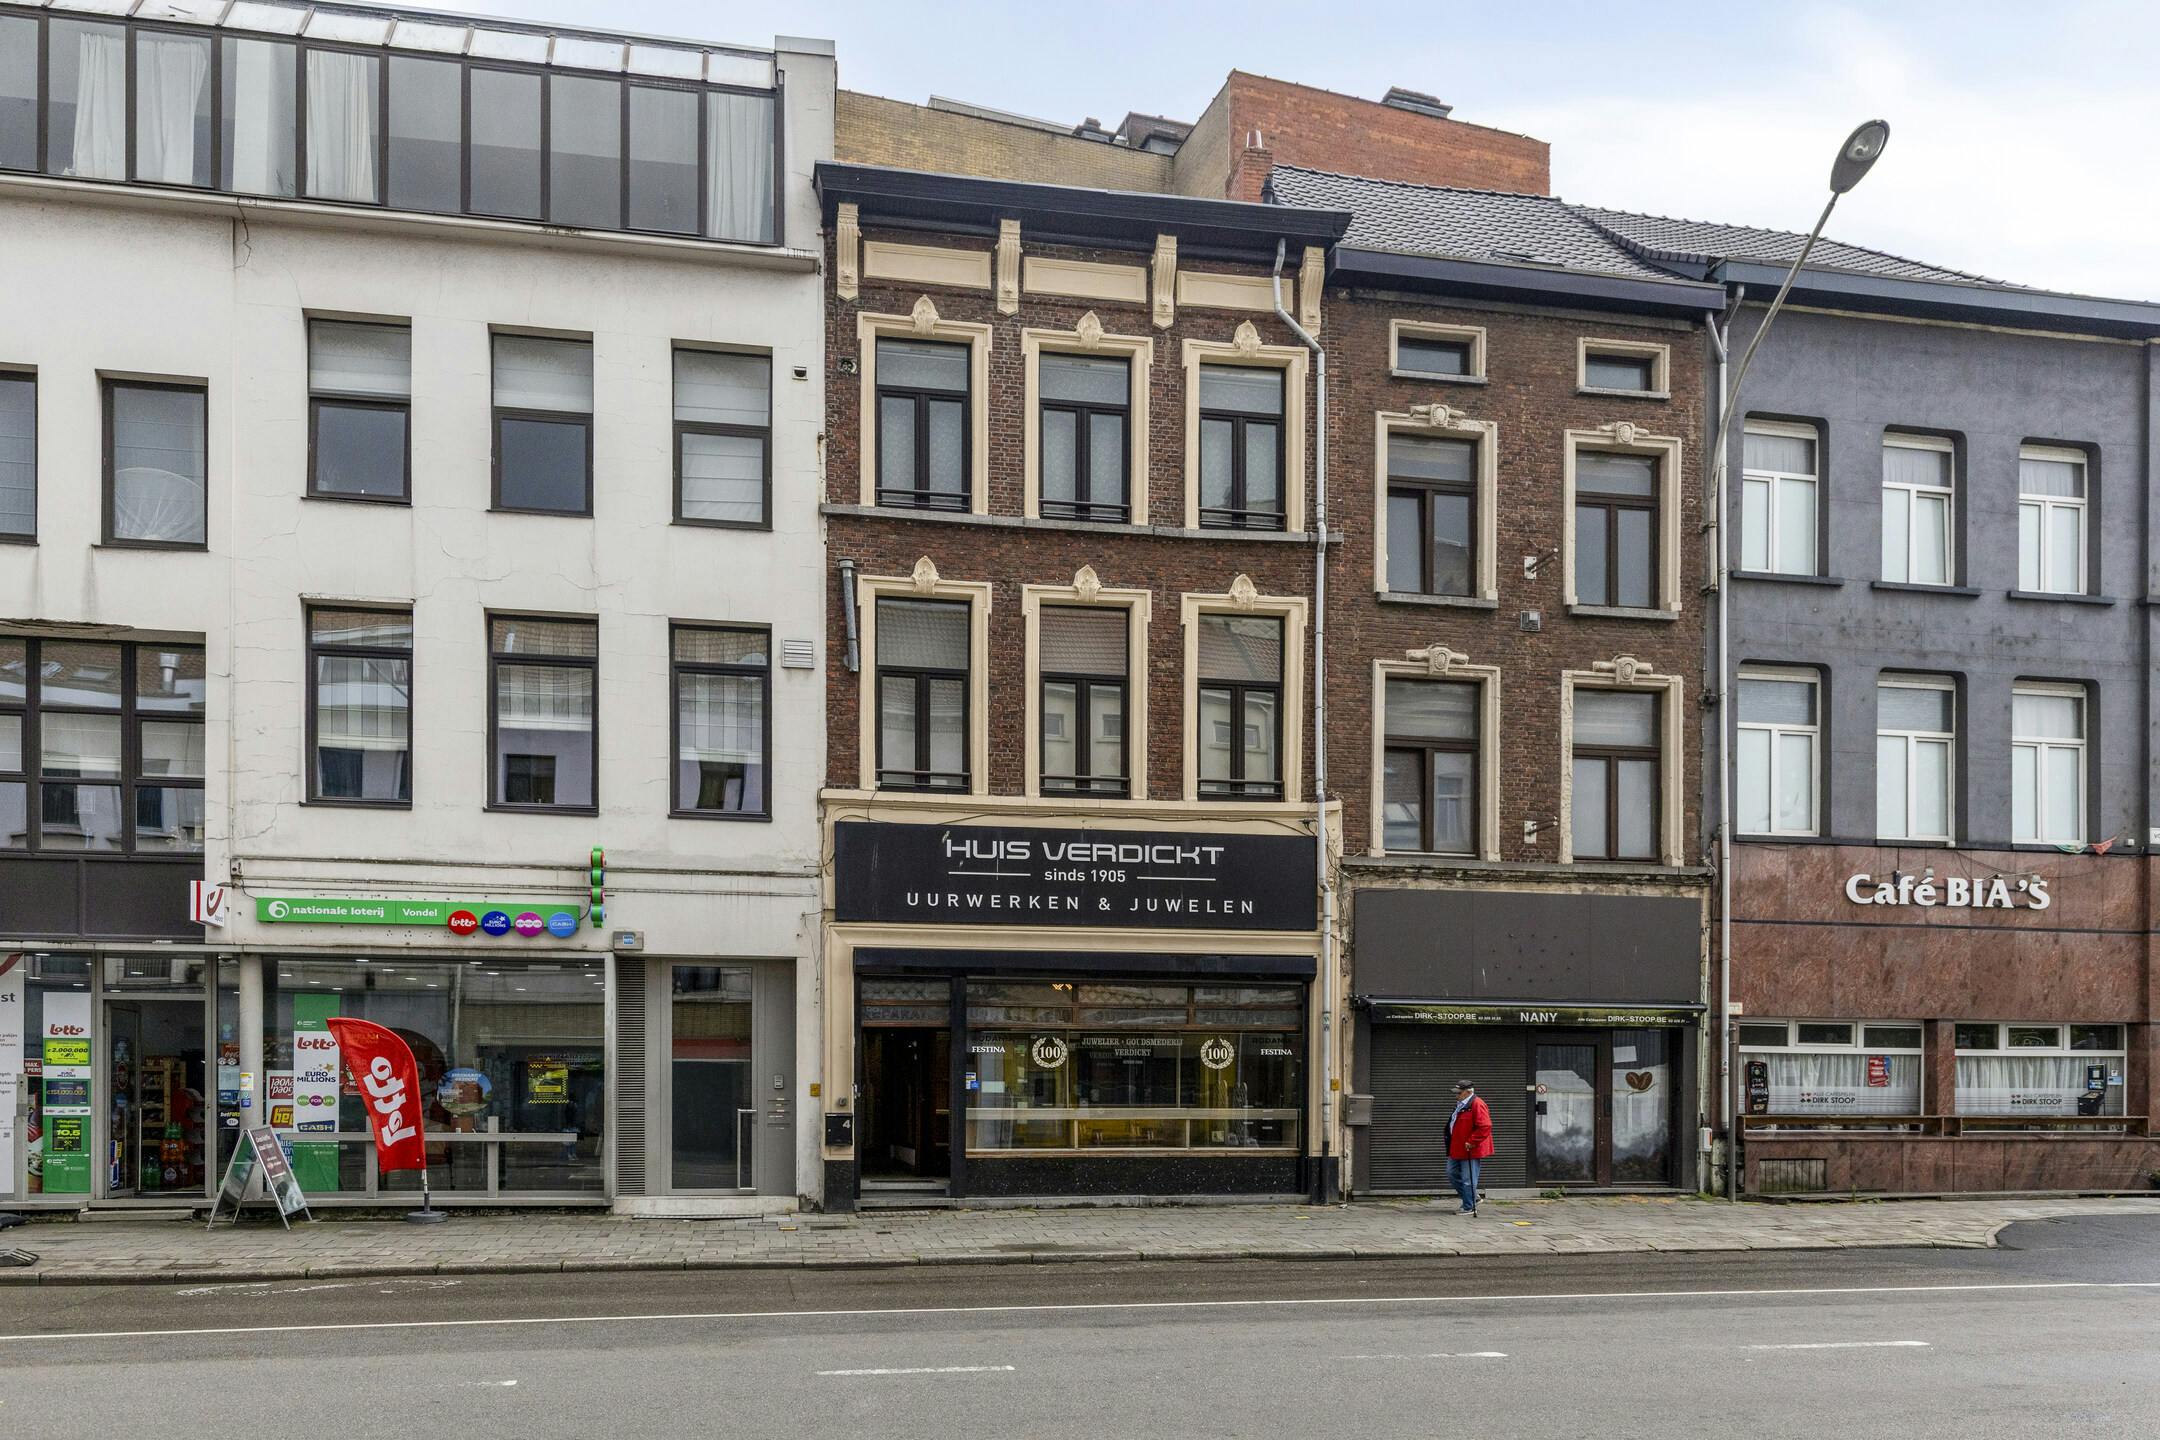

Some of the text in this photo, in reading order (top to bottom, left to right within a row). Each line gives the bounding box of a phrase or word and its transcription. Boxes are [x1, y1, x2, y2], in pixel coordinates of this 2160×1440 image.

[946, 839, 1225, 865] HUIS VERDICKT
[1044, 868, 1126, 883] sinds 1905
[1845, 874, 1937, 906] Café
[906, 892, 1253, 914] UURWERKEN & JUWELEN
[293, 906, 438, 918] nationale loterij Vondel
[1519, 1012, 1558, 1023] NANY
[1081, 1037, 1120, 1046] JUWELIER
[971, 1045, 1006, 1053] FESTINA
[1039, 1046, 1061, 1059] 100
[1114, 1048, 1152, 1057] VERDICKT
[1207, 1048, 1228, 1060] 100
[1260, 1048, 1293, 1056] FESTINA
[842, 1119, 851, 1129] 4
